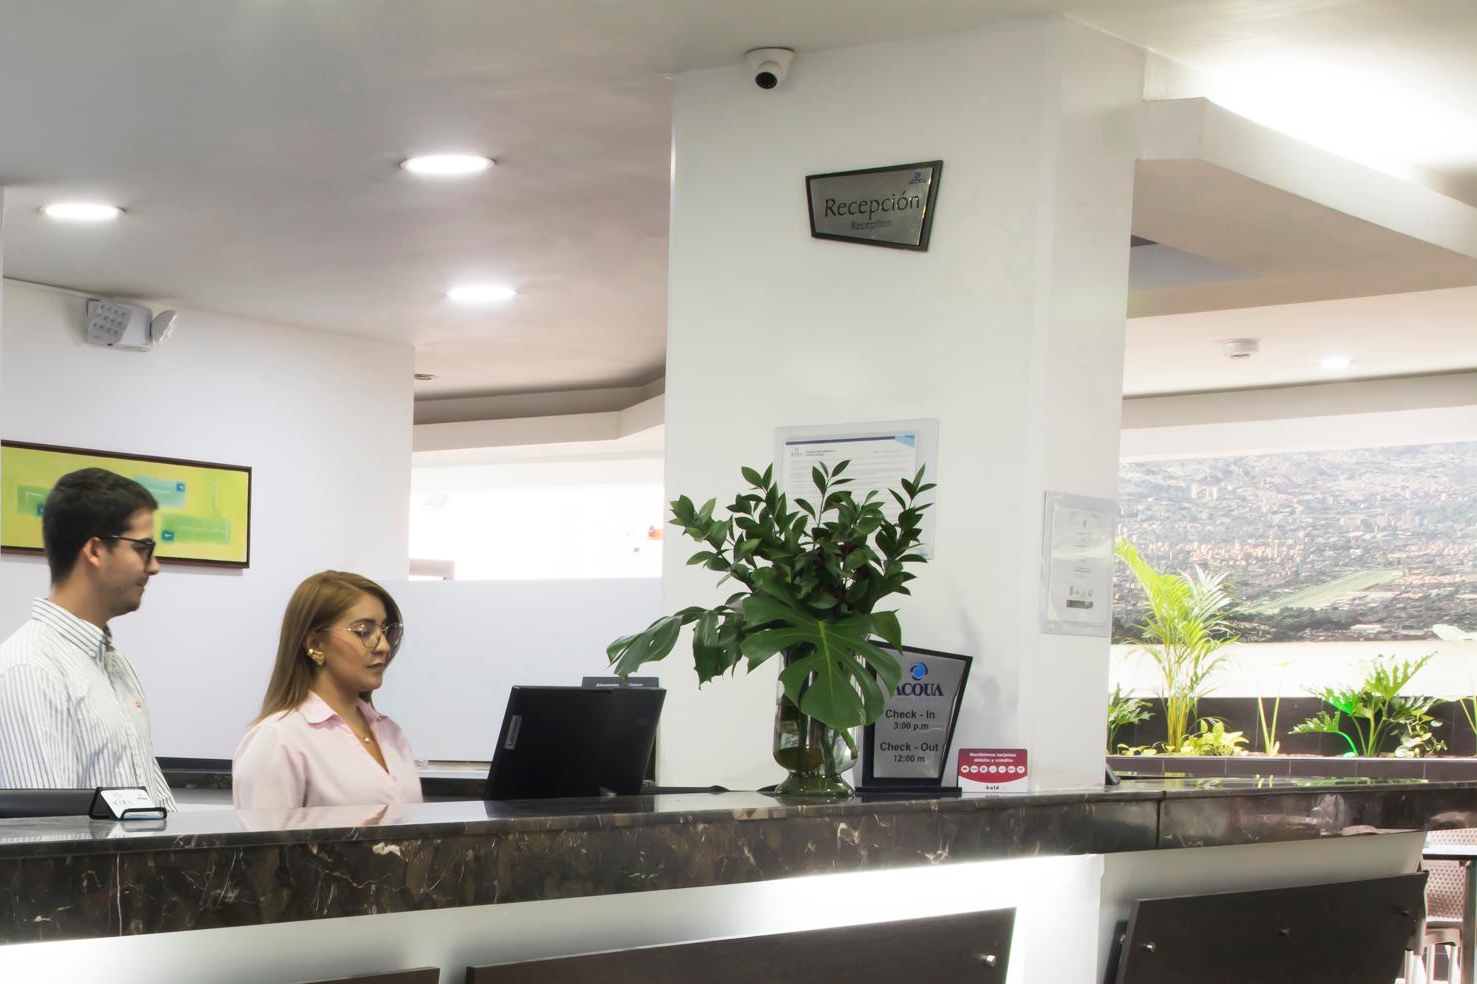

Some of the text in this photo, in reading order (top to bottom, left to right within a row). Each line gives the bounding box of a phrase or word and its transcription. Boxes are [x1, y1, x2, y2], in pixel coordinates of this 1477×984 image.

[824, 190, 920, 220] Recepción
[885, 709, 917, 719] Check
[926, 709, 936, 719] In
[893, 721, 930, 731] 3:00 p.m
[879, 742, 911, 751] Check
[920, 742, 939, 752] Out
[893, 754, 915, 763] 12:00
